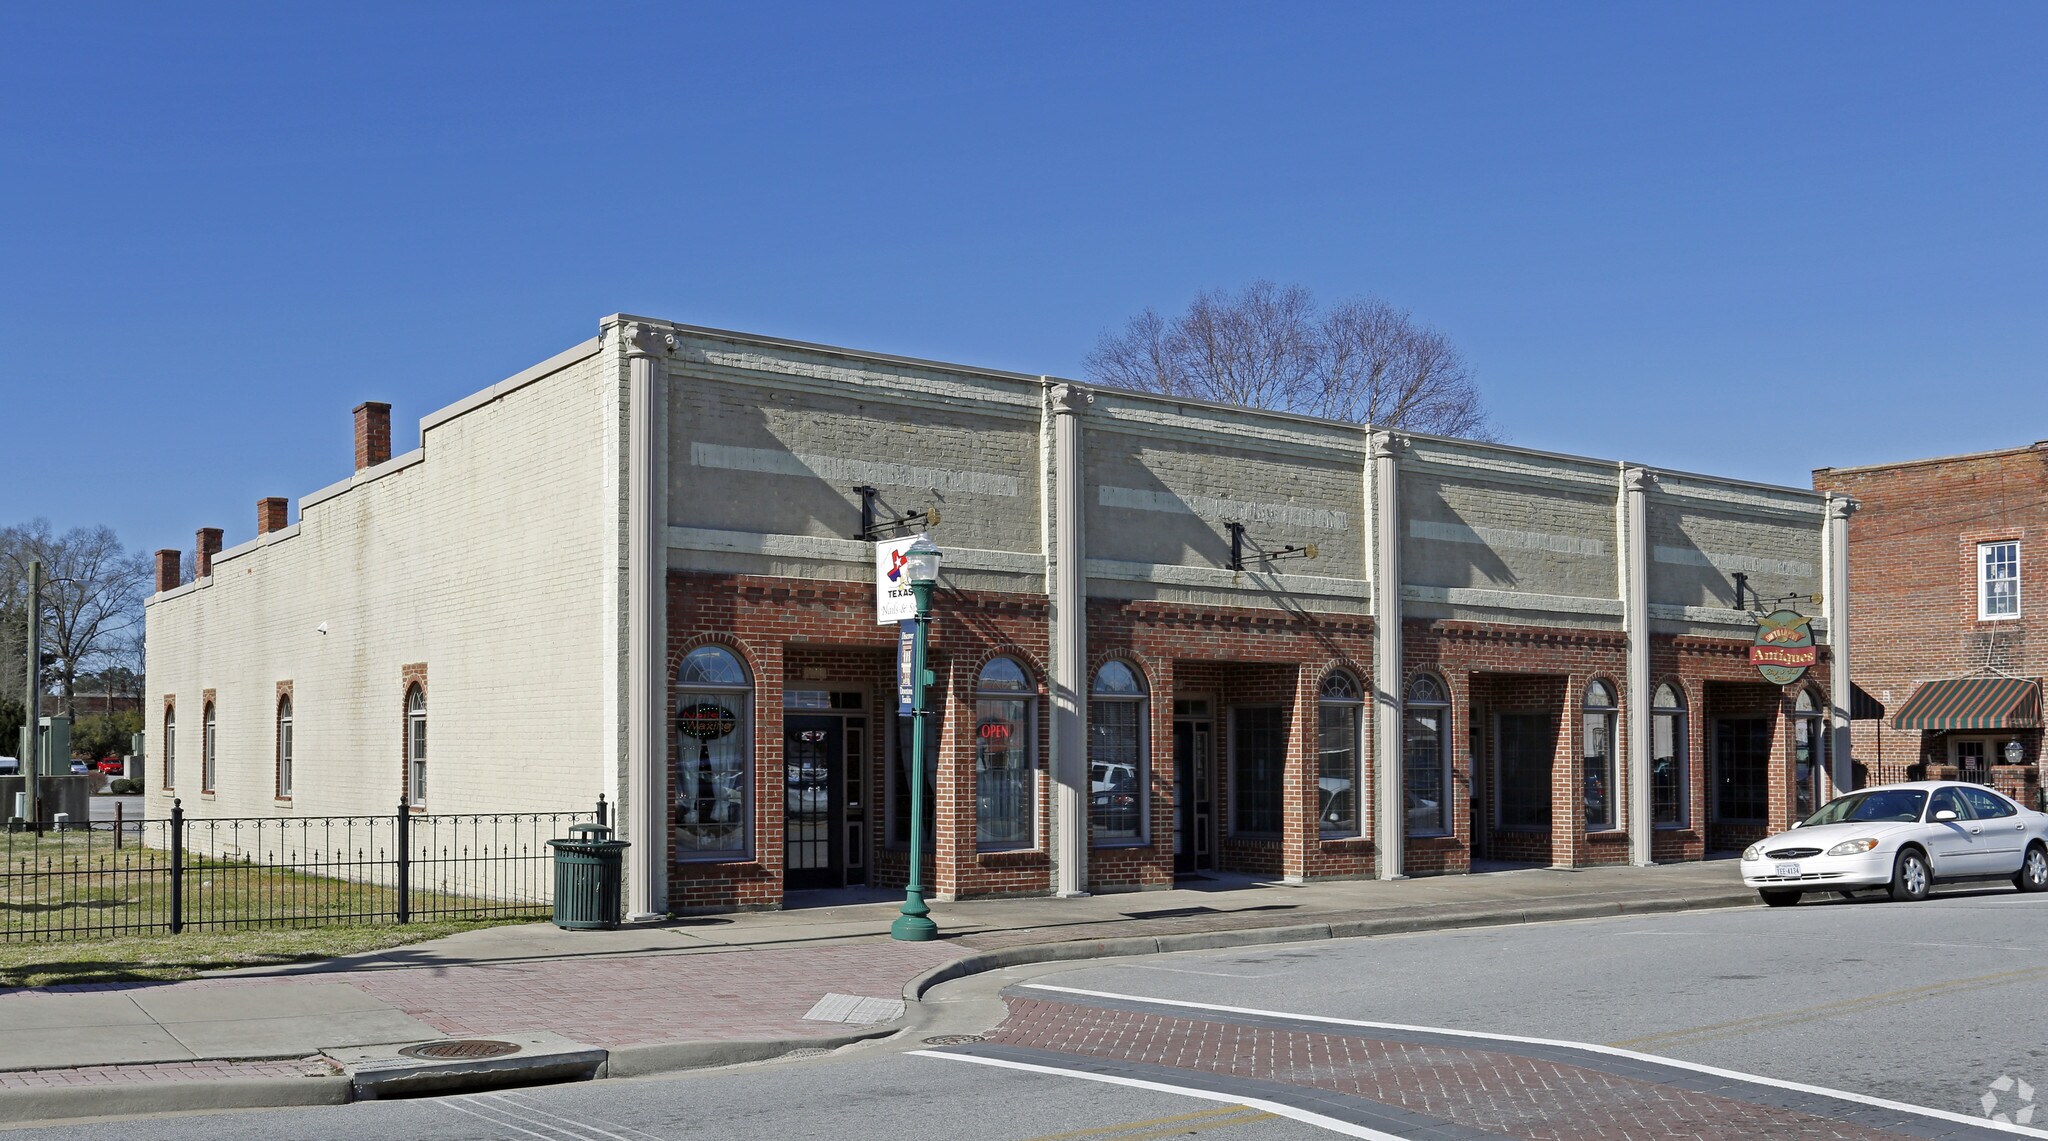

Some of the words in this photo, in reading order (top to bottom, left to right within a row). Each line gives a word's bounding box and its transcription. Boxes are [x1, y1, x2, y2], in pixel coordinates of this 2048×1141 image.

[888, 588, 913, 598] TEXAS
[881, 603, 899, 616] Nails
[1752, 649, 1814, 665] Antiques
[683, 710, 719, 720] Nails
[687, 721, 731, 733] Waxing
[981, 724, 1009, 738] OPEN
